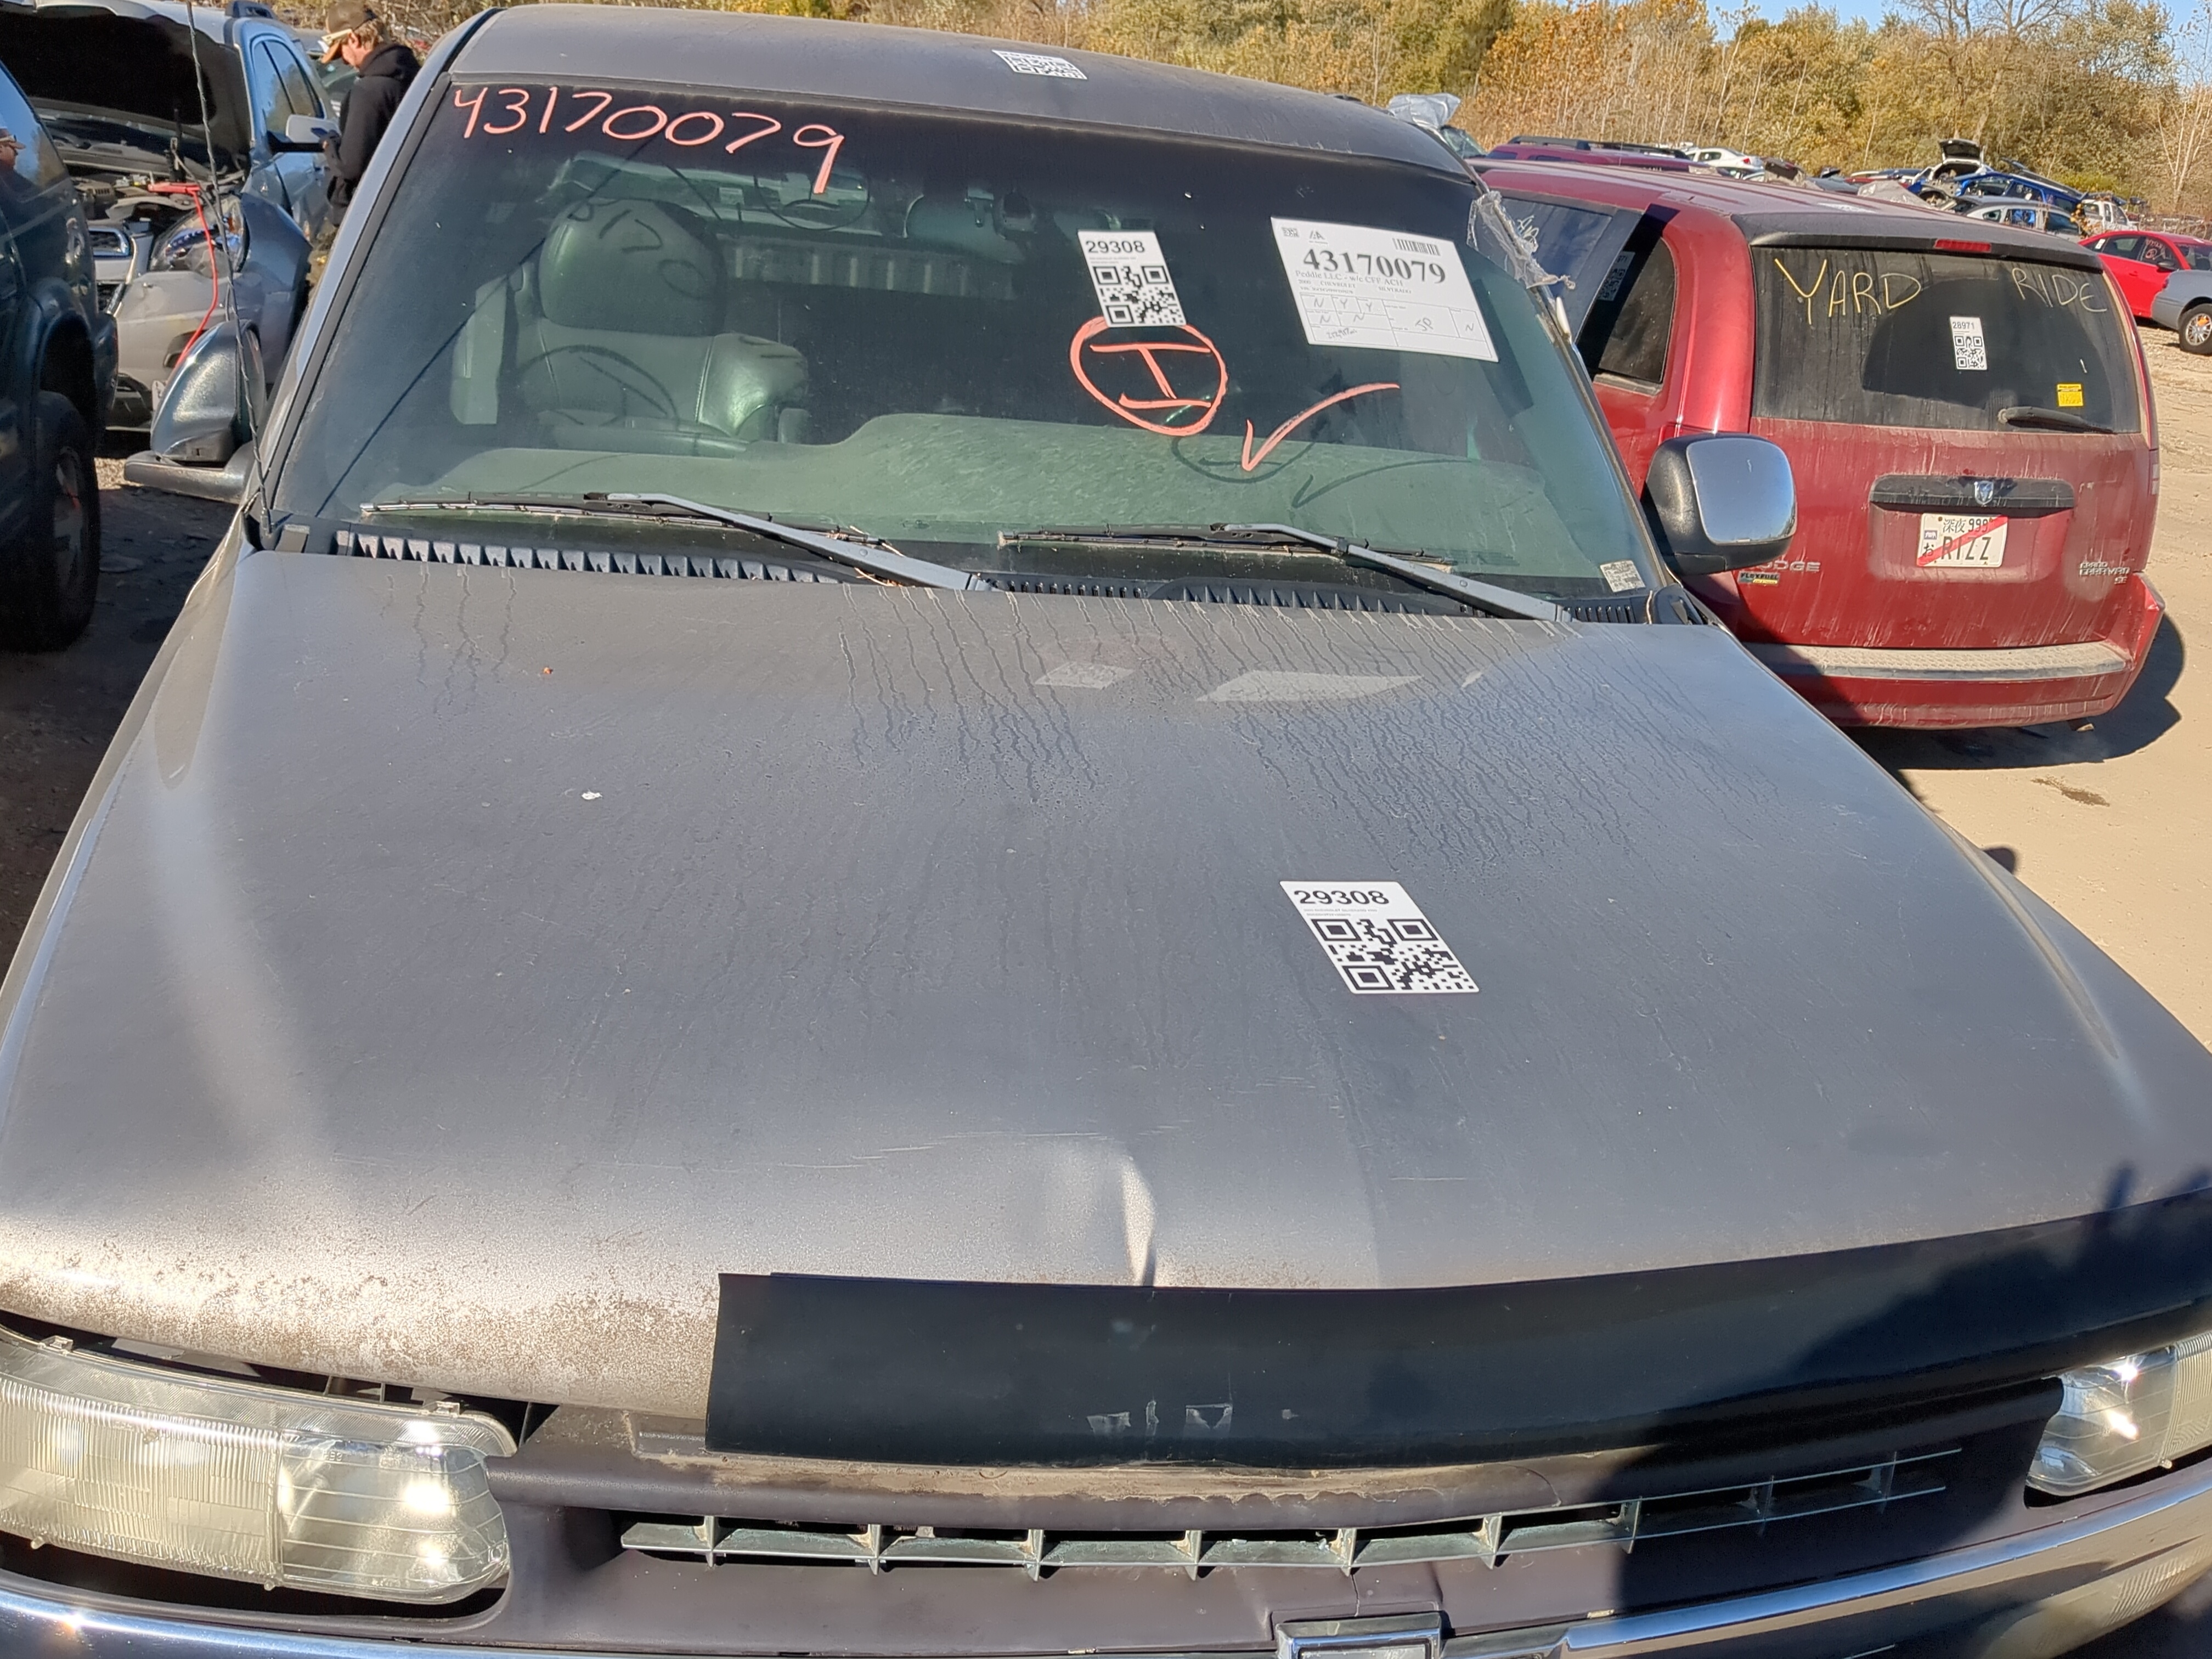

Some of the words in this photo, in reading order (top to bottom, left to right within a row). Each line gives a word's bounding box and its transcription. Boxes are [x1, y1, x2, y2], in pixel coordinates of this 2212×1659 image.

[454, 87, 844, 193] 43170079
[1086, 240, 1145, 253] 29308
[1303, 249, 1446, 284] 43170079
[1295, 270, 1322, 279] Peddle
[1324, 272, 1342, 280] LLC
[1384, 279, 1403, 287] ACH
[1320, 280, 1356, 289] CHEVROLET
[1378, 286, 1412, 294] SILVERADO
[1774, 258, 1922, 325] YARD
[2011, 267, 2108, 313] RIDE
[1340, 298, 1348, 309] Y
[1365, 302, 1372, 312] Y
[1943, 518, 1967, 533] 深夜
[1968, 518, 1989, 533] 999
[1922, 542, 1934, 558] お
[1941, 535, 1991, 561] RIZZ
[1756, 559, 1821, 572] ODGE
[2079, 567, 2130, 576] CARAVAN
[1294, 890, 1390, 905] 29308
